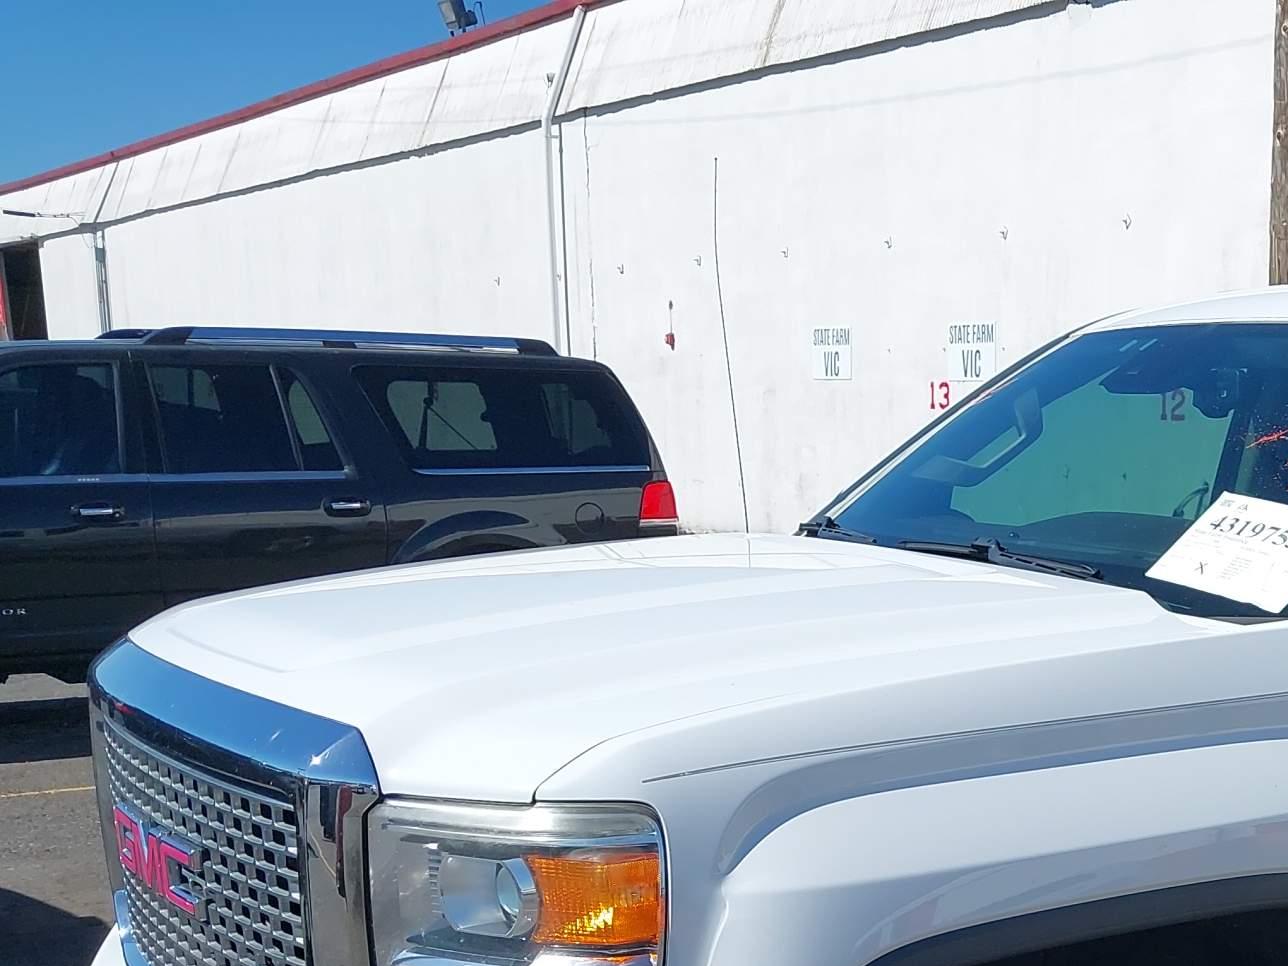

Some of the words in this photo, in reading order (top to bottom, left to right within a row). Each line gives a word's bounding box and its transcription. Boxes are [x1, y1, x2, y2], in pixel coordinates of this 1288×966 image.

[813, 328, 831, 346] STATE
[832, 327, 850, 346] FARM
[949, 324, 971, 345] STATE
[972, 323, 994, 344] FARM
[823, 351, 840, 377] VIC
[962, 349, 982, 378] VIC
[929, 381, 950, 410] 13
[1160, 389, 1186, 421] 12
[113, 803, 204, 920] GMC
